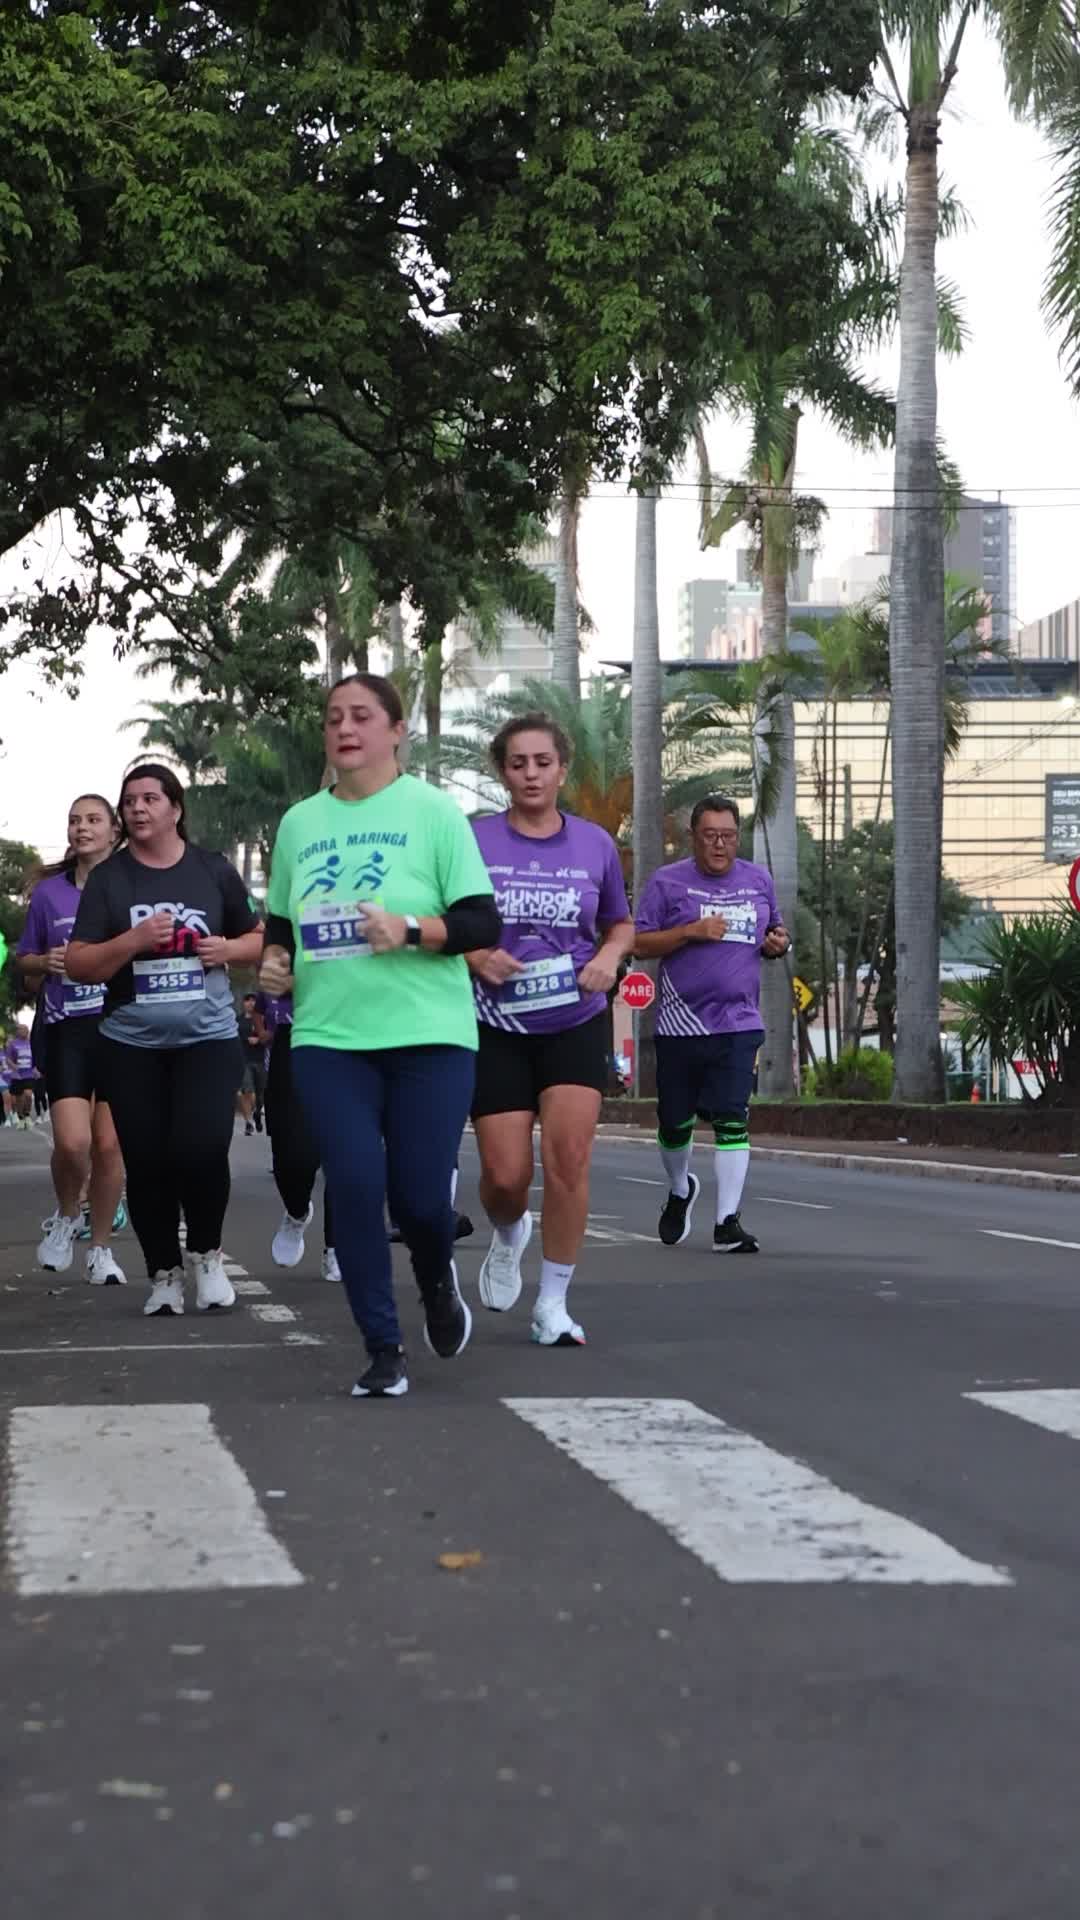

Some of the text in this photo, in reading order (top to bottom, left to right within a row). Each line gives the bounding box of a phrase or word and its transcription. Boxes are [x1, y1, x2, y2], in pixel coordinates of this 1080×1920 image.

[297, 838, 337, 864] CORRA
[494, 889, 572, 905] MUNDO
[148, 973, 189, 989] 5455
[514, 975, 559, 996] 6328
[622, 985, 652, 997] PARE
